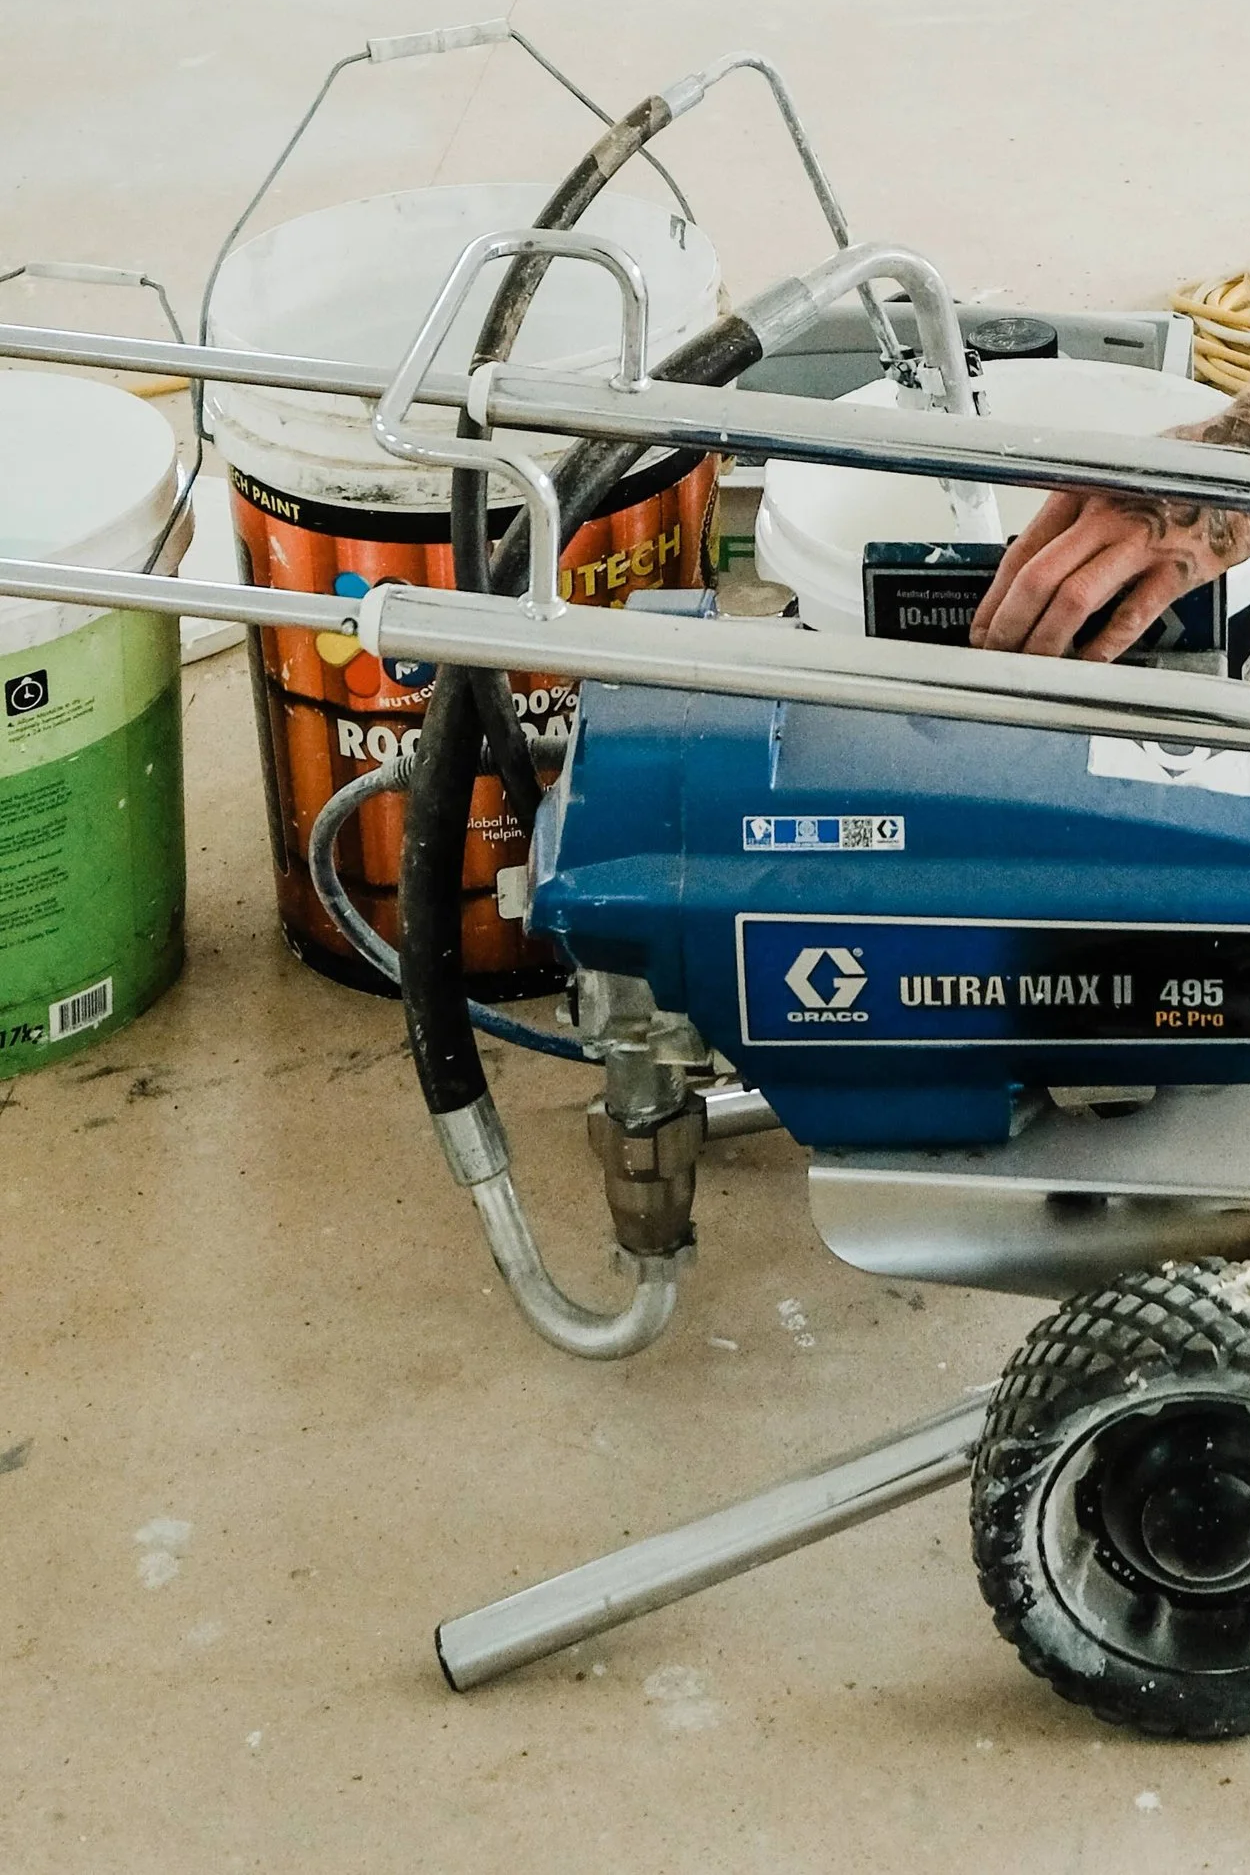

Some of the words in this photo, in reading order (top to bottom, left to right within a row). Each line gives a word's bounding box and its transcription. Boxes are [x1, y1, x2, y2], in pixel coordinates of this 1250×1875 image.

[252, 485, 300, 520] PAINT
[899, 606, 977, 630] ontrol
[483, 829, 526, 841] Helpin
[900, 975, 1006, 1006] ULTRA
[1019, 975, 1100, 1005] MAX
[1113, 975, 1132, 1005] II
[1160, 979, 1223, 1006] 495
[787, 1011, 869, 1023] GRACO
[1155, 1011, 1183, 1027] PC
[1187, 1011, 1224, 1027] Pro
